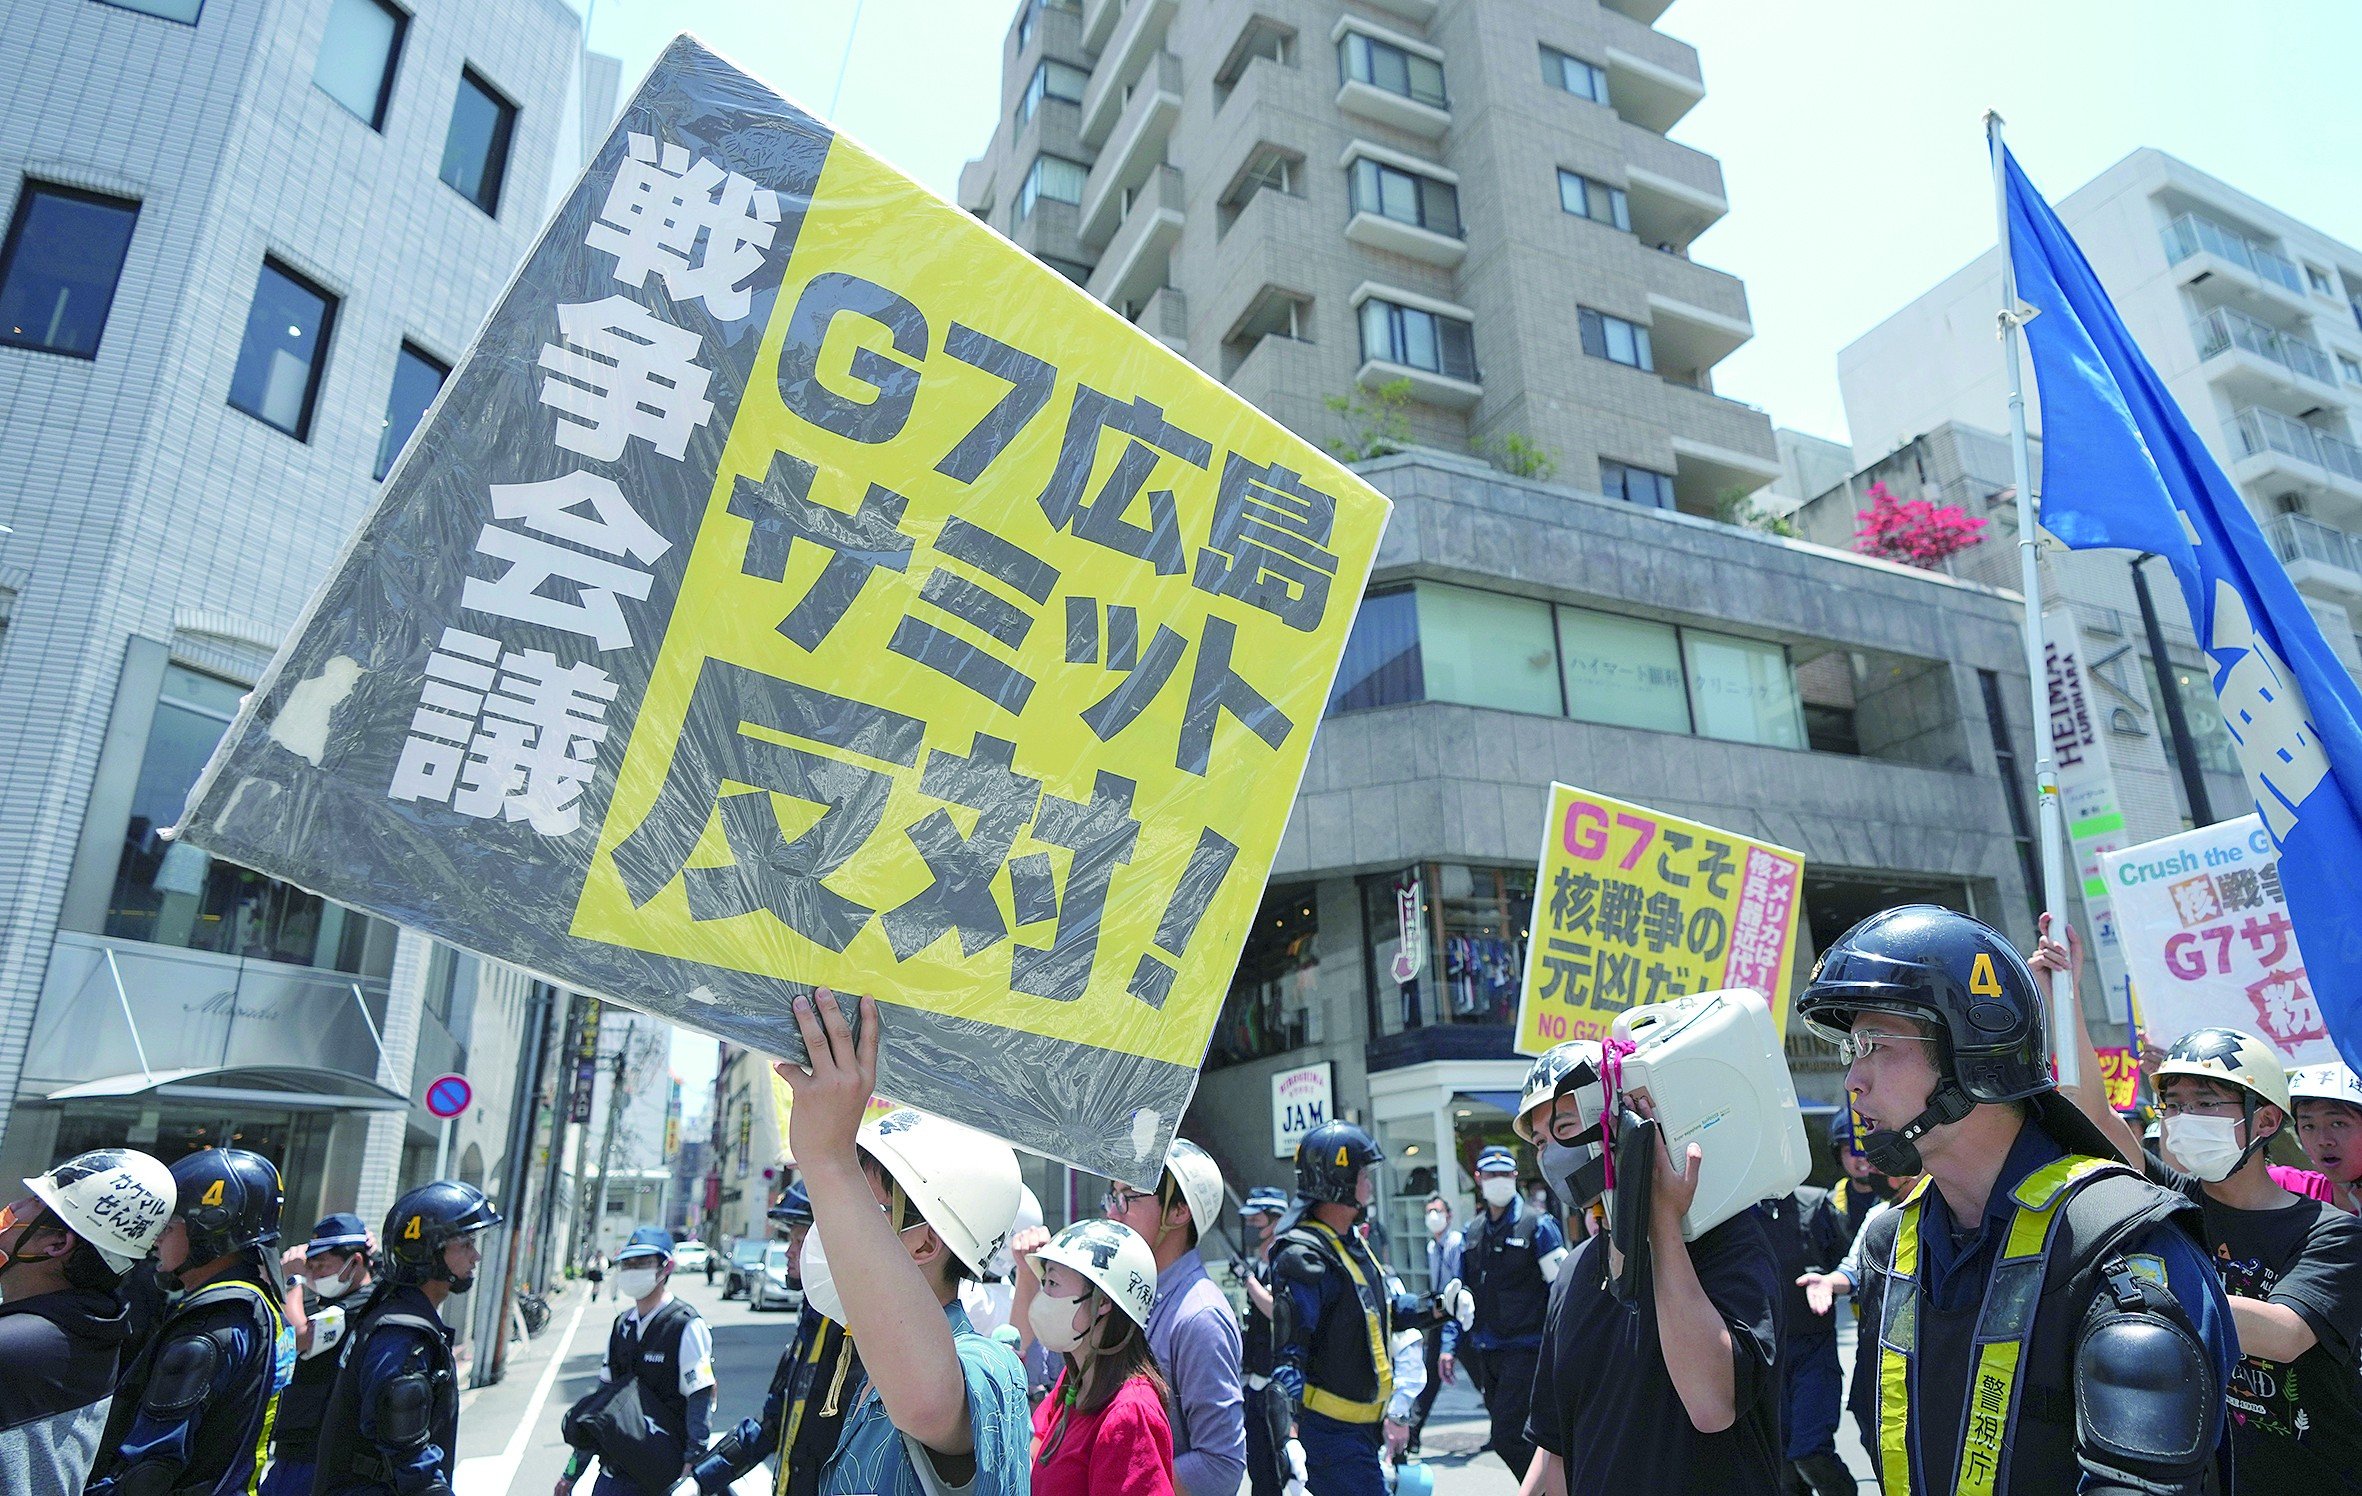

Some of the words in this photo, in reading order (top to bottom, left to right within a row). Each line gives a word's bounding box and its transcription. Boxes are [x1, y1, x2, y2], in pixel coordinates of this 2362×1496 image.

[387, 130, 782, 837] 戦争会議
[777, 271, 1339, 634] G7広島
[725, 449, 1295, 778] サミット
[2063, 653, 2095, 747] KURIHARA
[609, 655, 1240, 1012] 反対!
[1563, 801, 1736, 900] G7こそ
[2118, 848, 2199, 887] Crush
[2204, 845, 2243, 868] the
[1549, 866, 1727, 963] 核戦争の
[1968, 953, 2003, 998] 4
[1538, 1013, 1566, 1040] NO
[1283, 1101, 1323, 1132] JAM
[1335, 1146, 1349, 1167] 4
[202, 1180, 223, 1206] 4
[404, 1215, 421, 1240] 4
[1966, 1374, 2006, 1486] 警視庁
